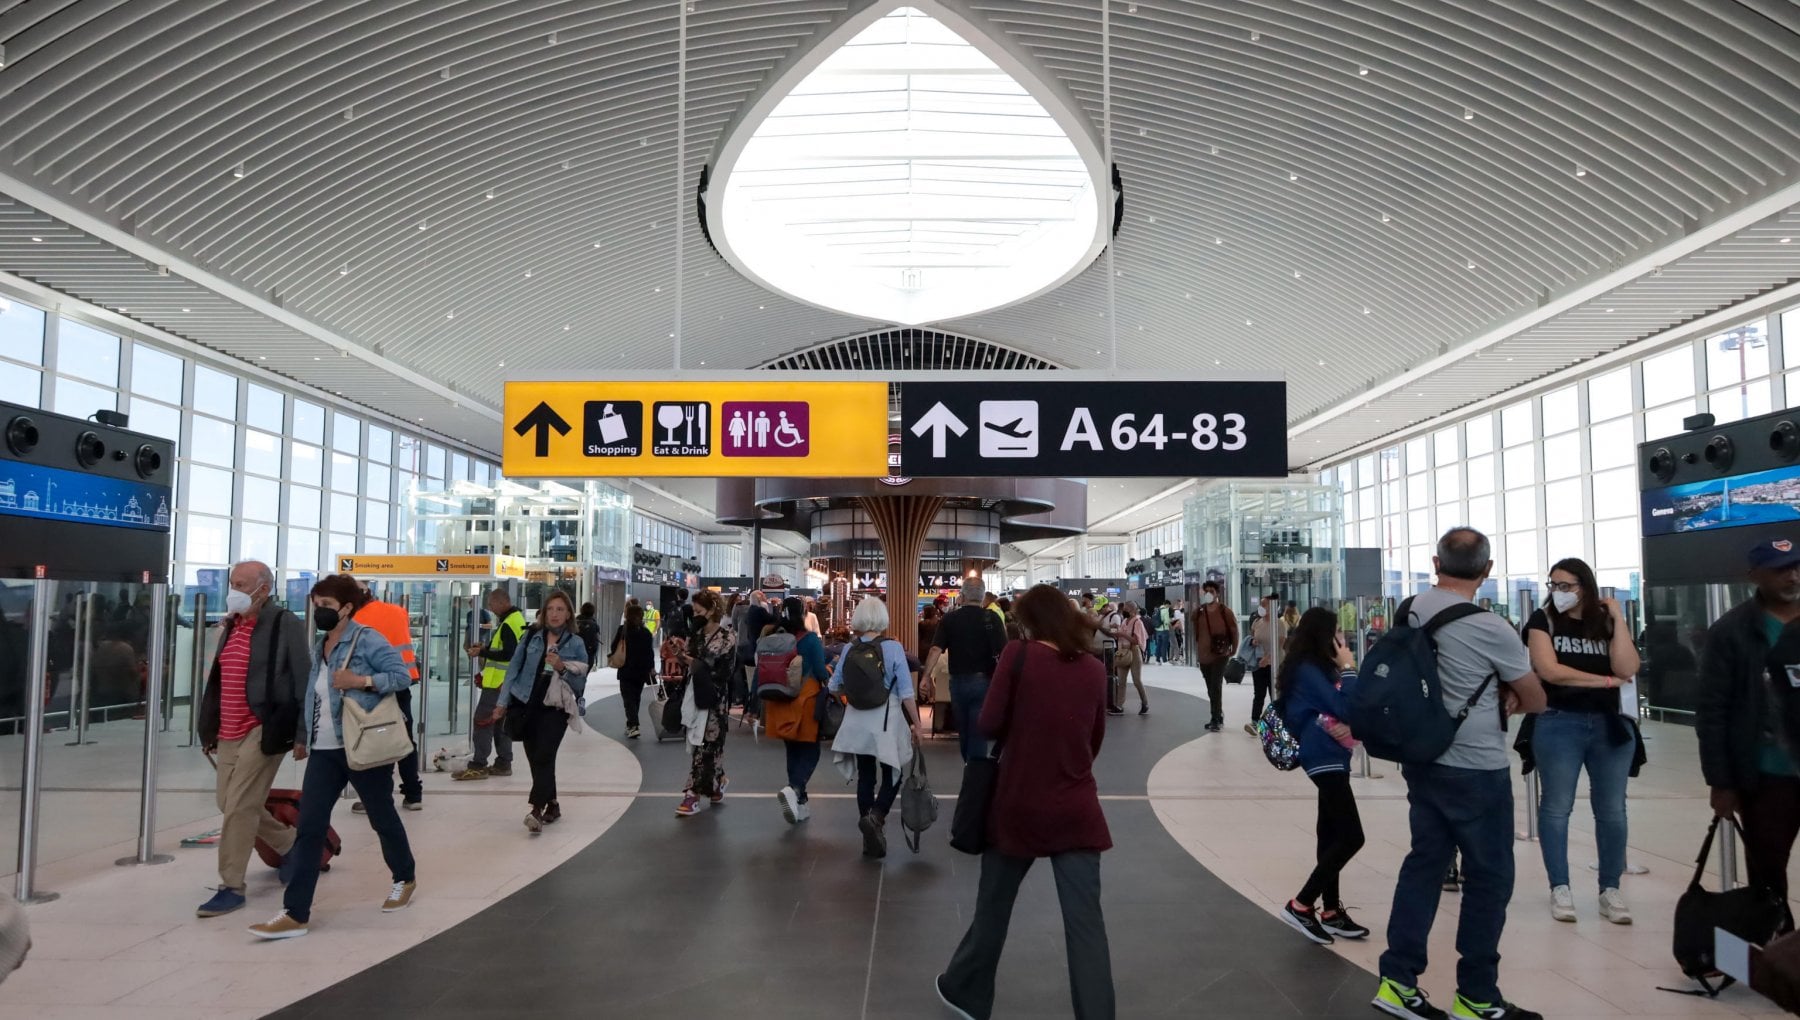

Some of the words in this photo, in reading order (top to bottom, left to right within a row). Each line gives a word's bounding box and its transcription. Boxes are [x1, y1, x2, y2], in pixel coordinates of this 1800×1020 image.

[1060, 407, 1104, 451] A
[1110, 412, 1247, 451] 64-83
[588, 444, 637, 456] Shopping
[654, 446, 670, 455] Eat
[671, 446, 680, 455] &
[681, 446, 708, 455] Drink
[354, 562, 380, 570] Smoking
[450, 562, 475, 570] Smoking
